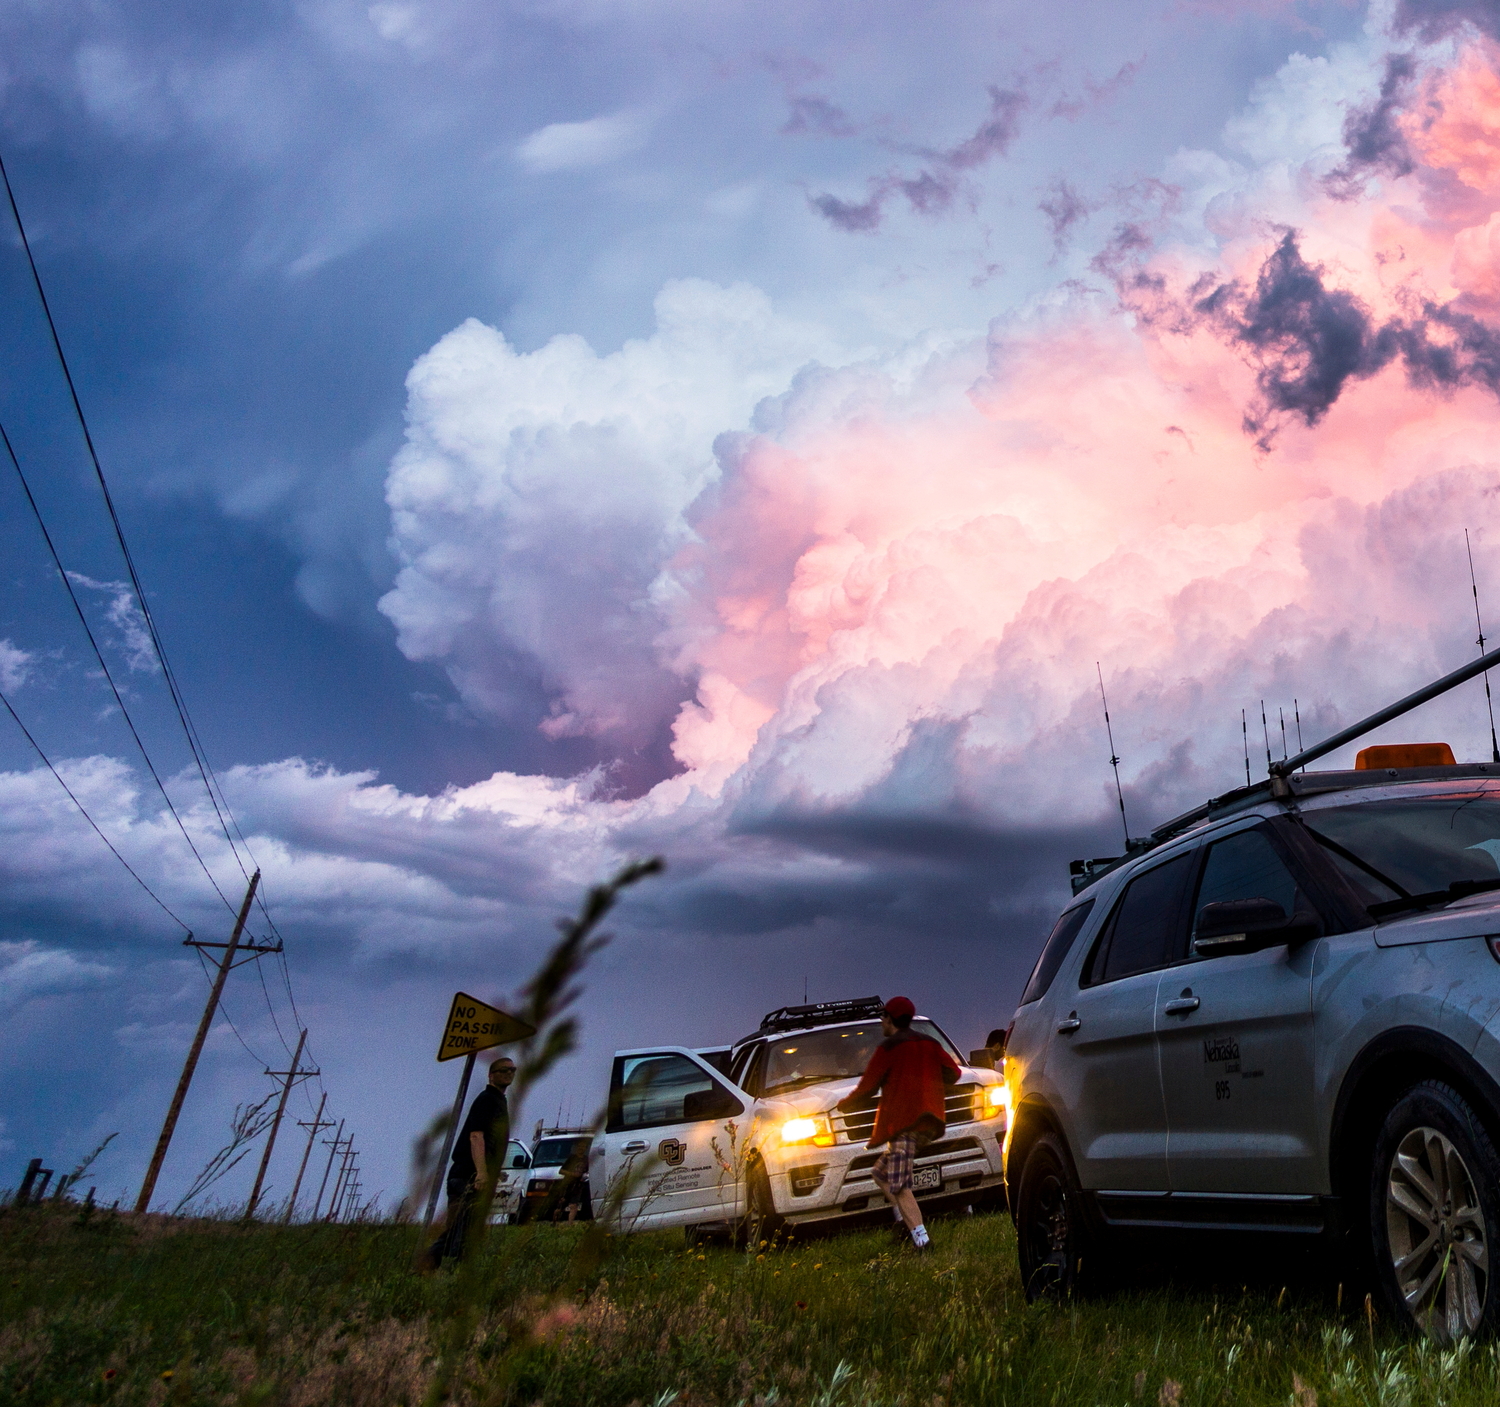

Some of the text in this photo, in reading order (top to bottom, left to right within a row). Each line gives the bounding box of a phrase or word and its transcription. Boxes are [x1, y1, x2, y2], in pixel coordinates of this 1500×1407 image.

[455, 1007, 477, 1019] NO
[451, 1021, 505, 1035] PASSIN
[447, 1036, 479, 1048] ZONE
[1203, 1037, 1240, 1063] Nebraska
[1216, 1081, 1231, 1100] 895
[658, 1138, 687, 1166] CU
[677, 1173, 700, 1181] Remote
[676, 1181, 699, 1189] Sensing
